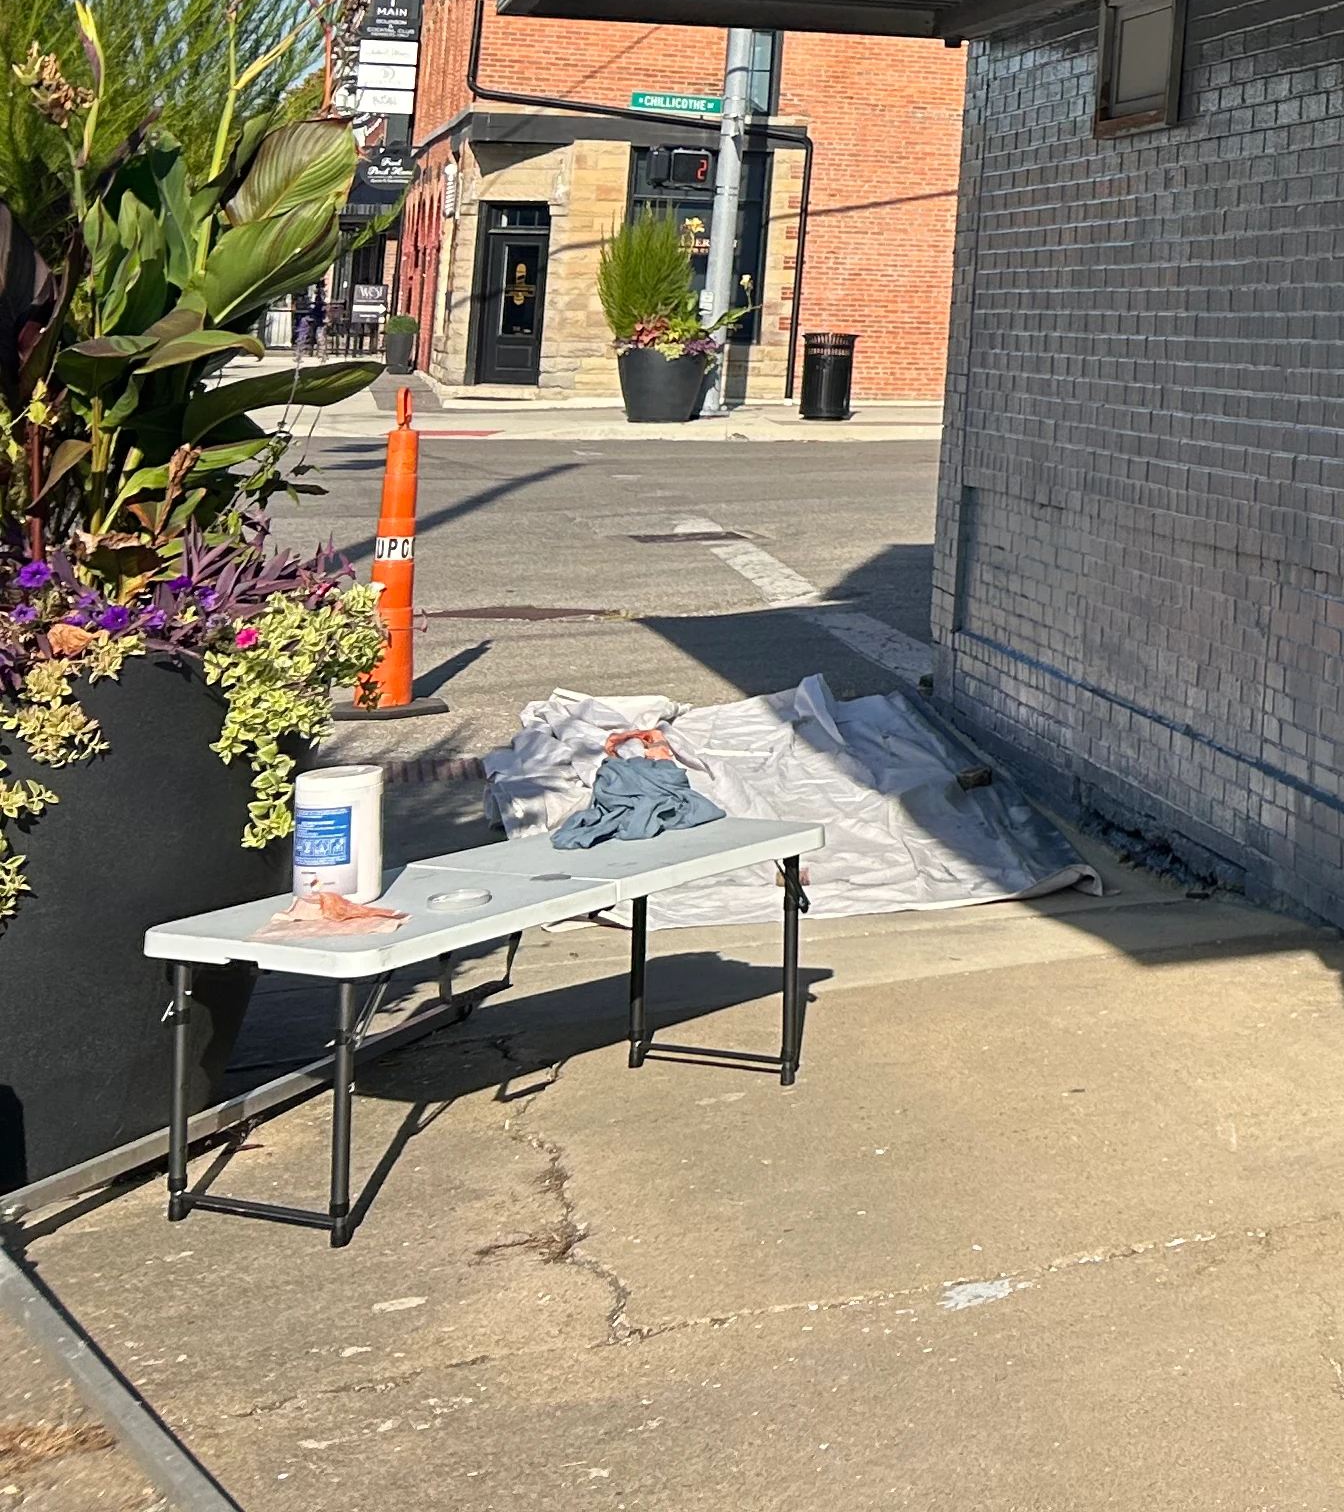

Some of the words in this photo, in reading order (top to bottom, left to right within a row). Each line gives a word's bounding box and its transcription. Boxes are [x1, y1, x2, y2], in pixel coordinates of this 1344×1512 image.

[376, 7, 408, 17] MAIN
[644, 95, 707, 110] CHILLICOTHE
[696, 159, 708, 181] 2
